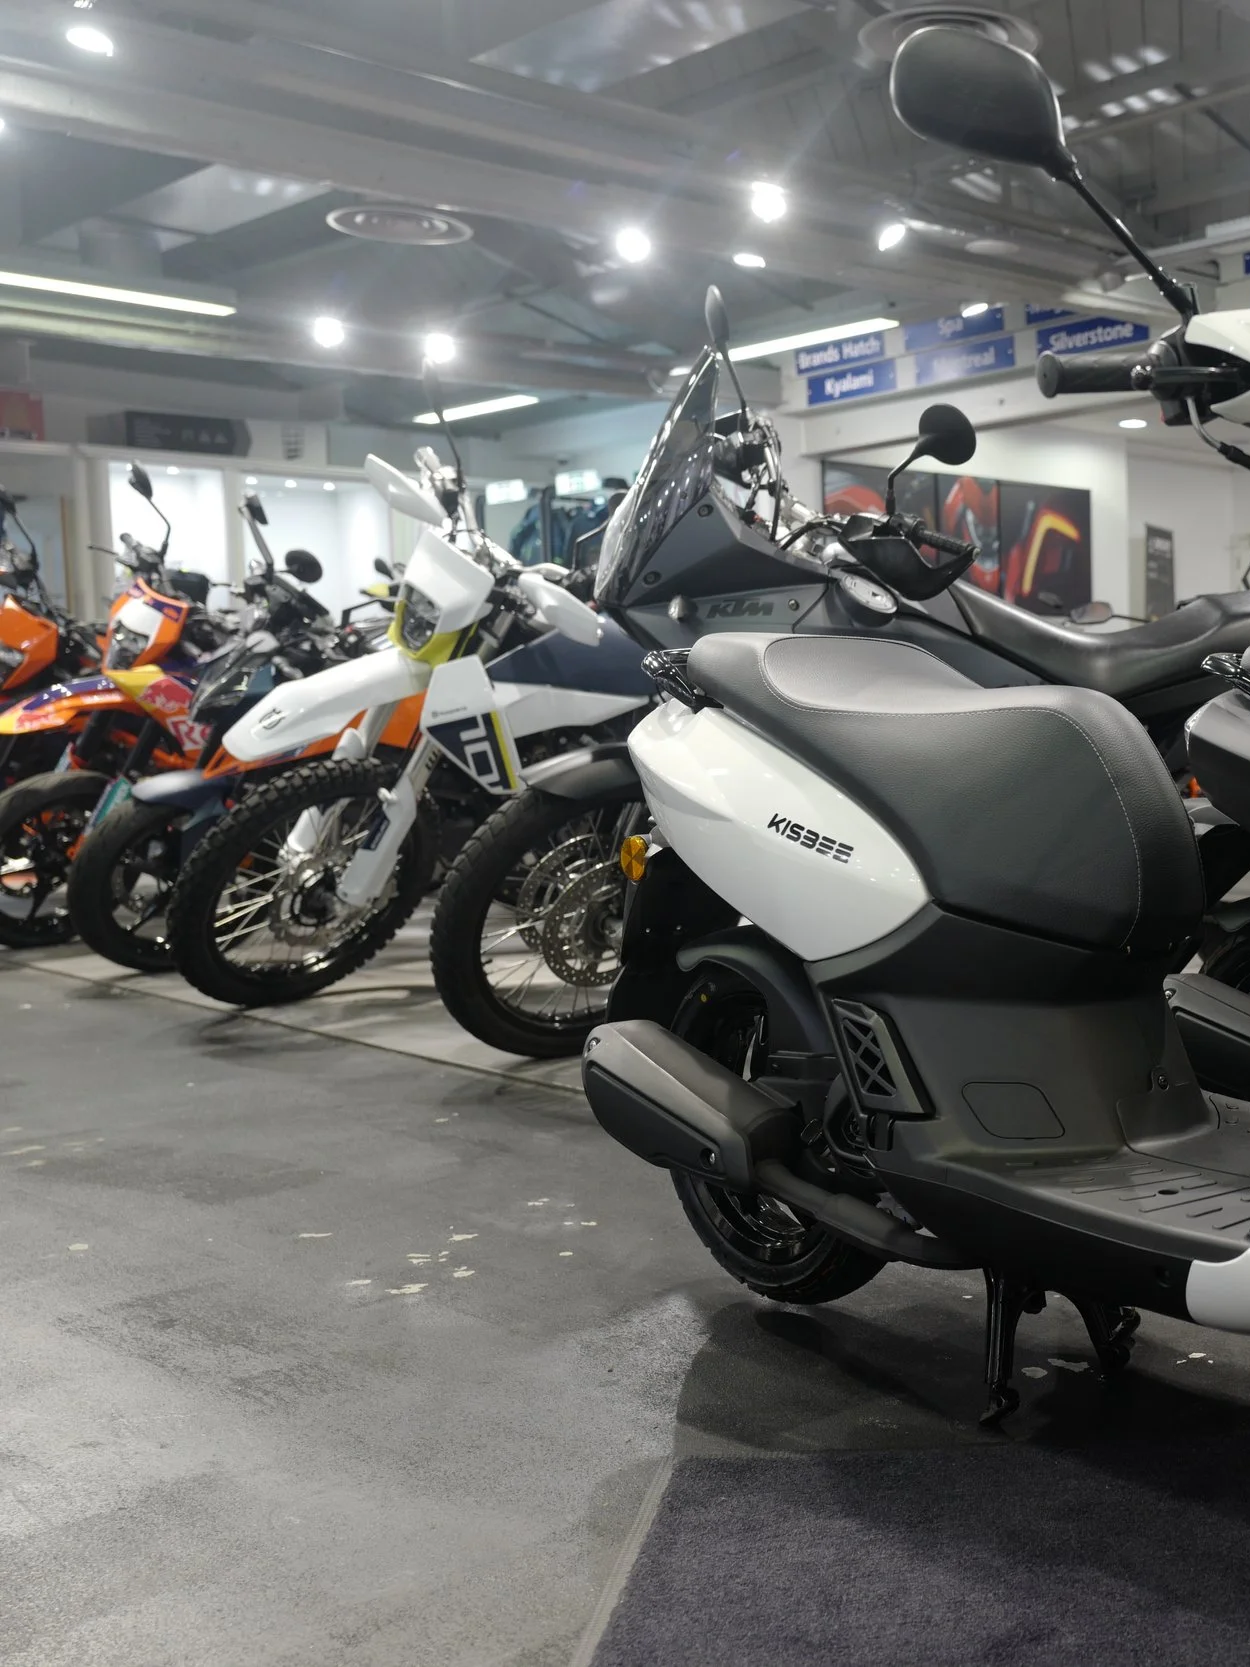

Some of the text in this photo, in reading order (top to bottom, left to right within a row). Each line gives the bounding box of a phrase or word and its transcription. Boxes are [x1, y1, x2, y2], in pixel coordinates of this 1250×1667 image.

[1048, 322, 1135, 352] Silverstone
[797, 336, 880, 370] Brands Hatch
[824, 370, 874, 398] Kyalami
[707, 600, 774, 618] KTM
[767, 812, 854, 863] KISBEE
